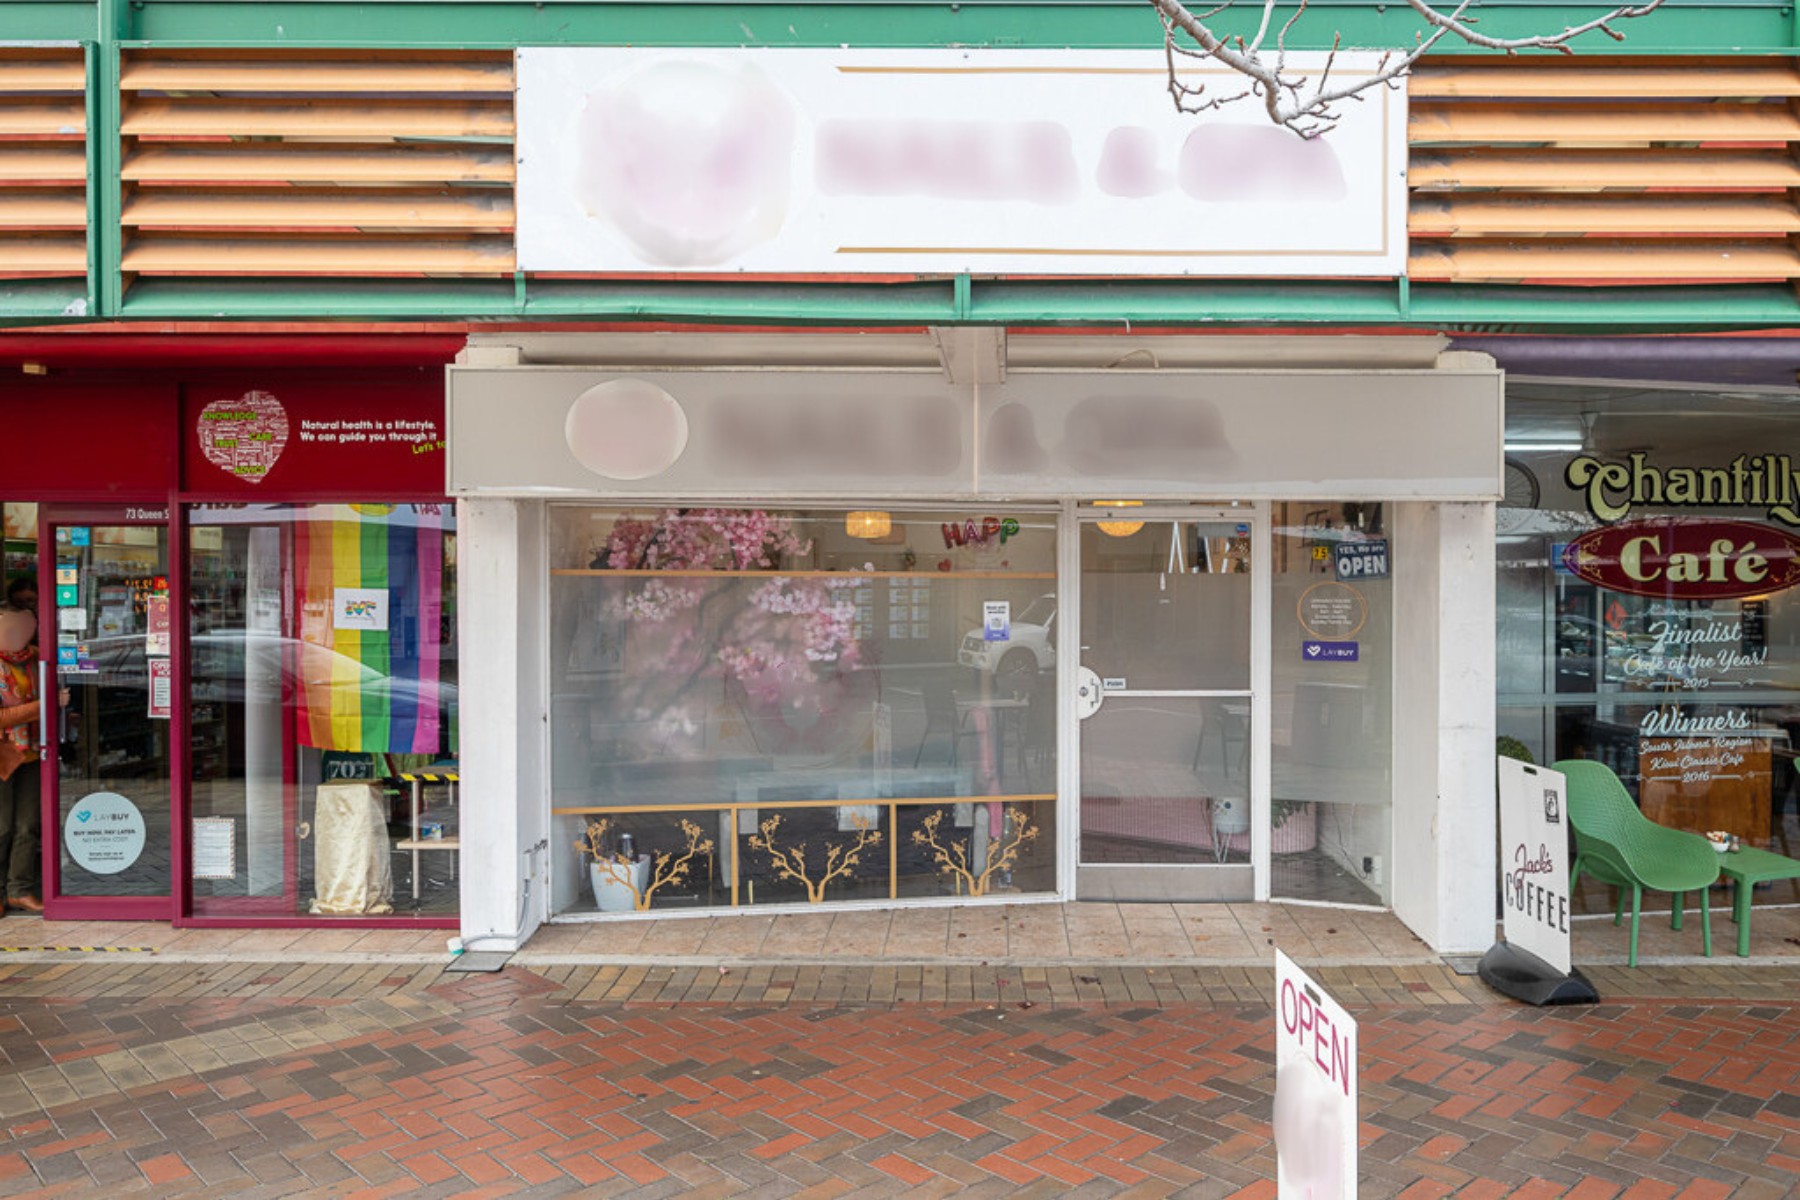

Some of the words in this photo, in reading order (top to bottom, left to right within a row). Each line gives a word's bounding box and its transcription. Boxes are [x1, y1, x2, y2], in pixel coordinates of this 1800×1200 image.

[300, 432, 315, 440] We
[339, 432, 366, 443] guide
[369, 433, 385, 442] you
[389, 432, 427, 443] through
[302, 420, 339, 429] Natural
[342, 420, 373, 429] health
[376, 420, 382, 429] is
[395, 420, 437, 431] lifestyle.
[125, 508, 136, 519] 73
[138, 508, 163, 519] Queen
[942, 517, 1019, 549] HAPP
[1339, 555, 1386, 577] OPEN
[1620, 535, 1769, 583] Café
[1648, 620, 1743, 652] Finalist
[1669, 655, 1688, 675] of
[1689, 654, 1715, 669] the
[1717, 647, 1768, 673] Year!
[1641, 705, 1751, 736] Winners
[1640, 740, 1672, 754] South
[1672, 738, 1711, 752] Island
[1713, 736, 1753, 749] Region
[1650, 757, 1680, 770] Kiwi
[1680, 755, 1718, 769] Classic
[1683, 772, 1710, 783] 2016
[1513, 843, 1553, 891] Jack's
[1506, 872, 1567, 934] COFFEE
[1281, 978, 1349, 1096] OPEN
